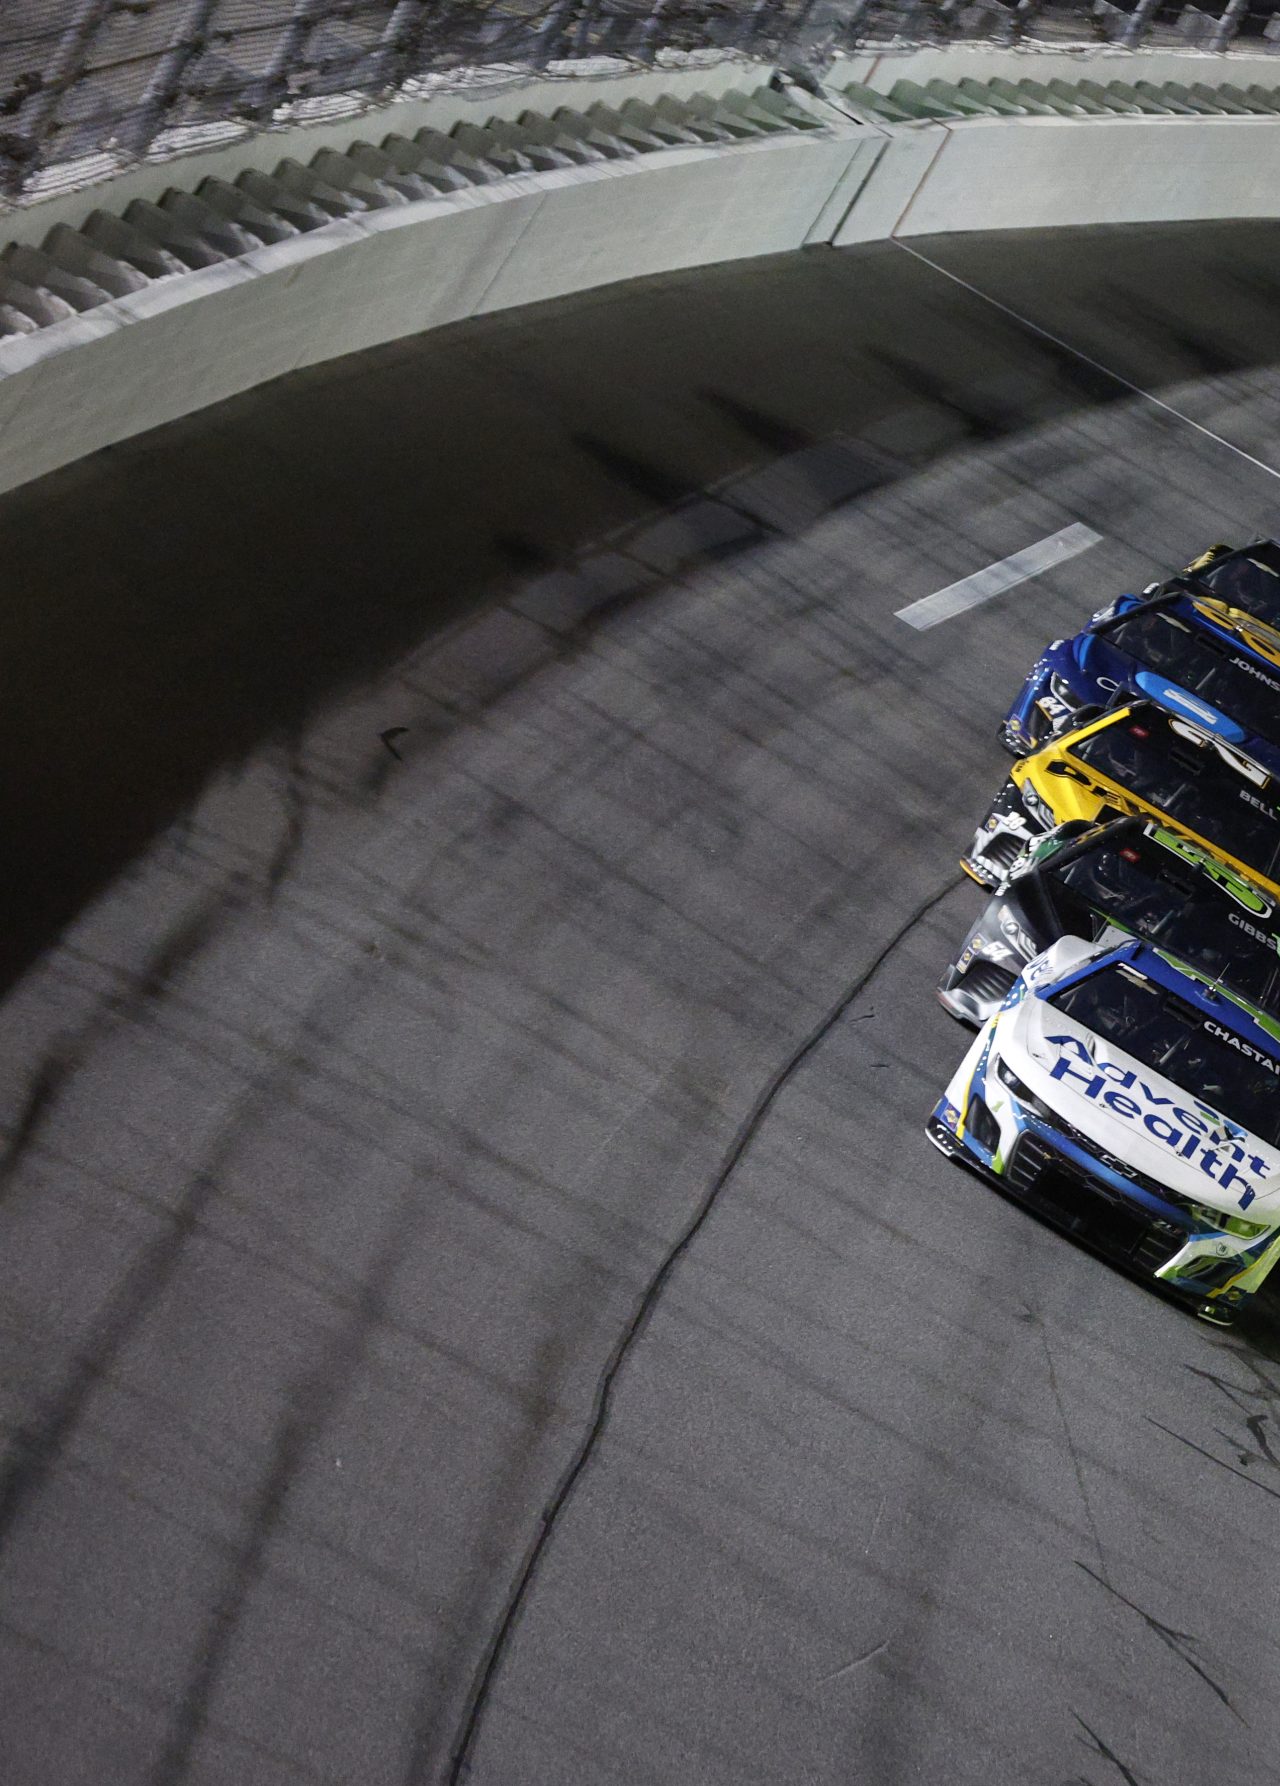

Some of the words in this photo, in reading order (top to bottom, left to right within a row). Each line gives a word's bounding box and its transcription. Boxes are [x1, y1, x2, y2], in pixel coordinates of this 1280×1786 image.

[1239, 789, 1279, 821] BELL
[1227, 911, 1279, 951] GIBBS
[1043, 1034, 1272, 1181] Advent
[1049, 1057, 1258, 1211] Health
